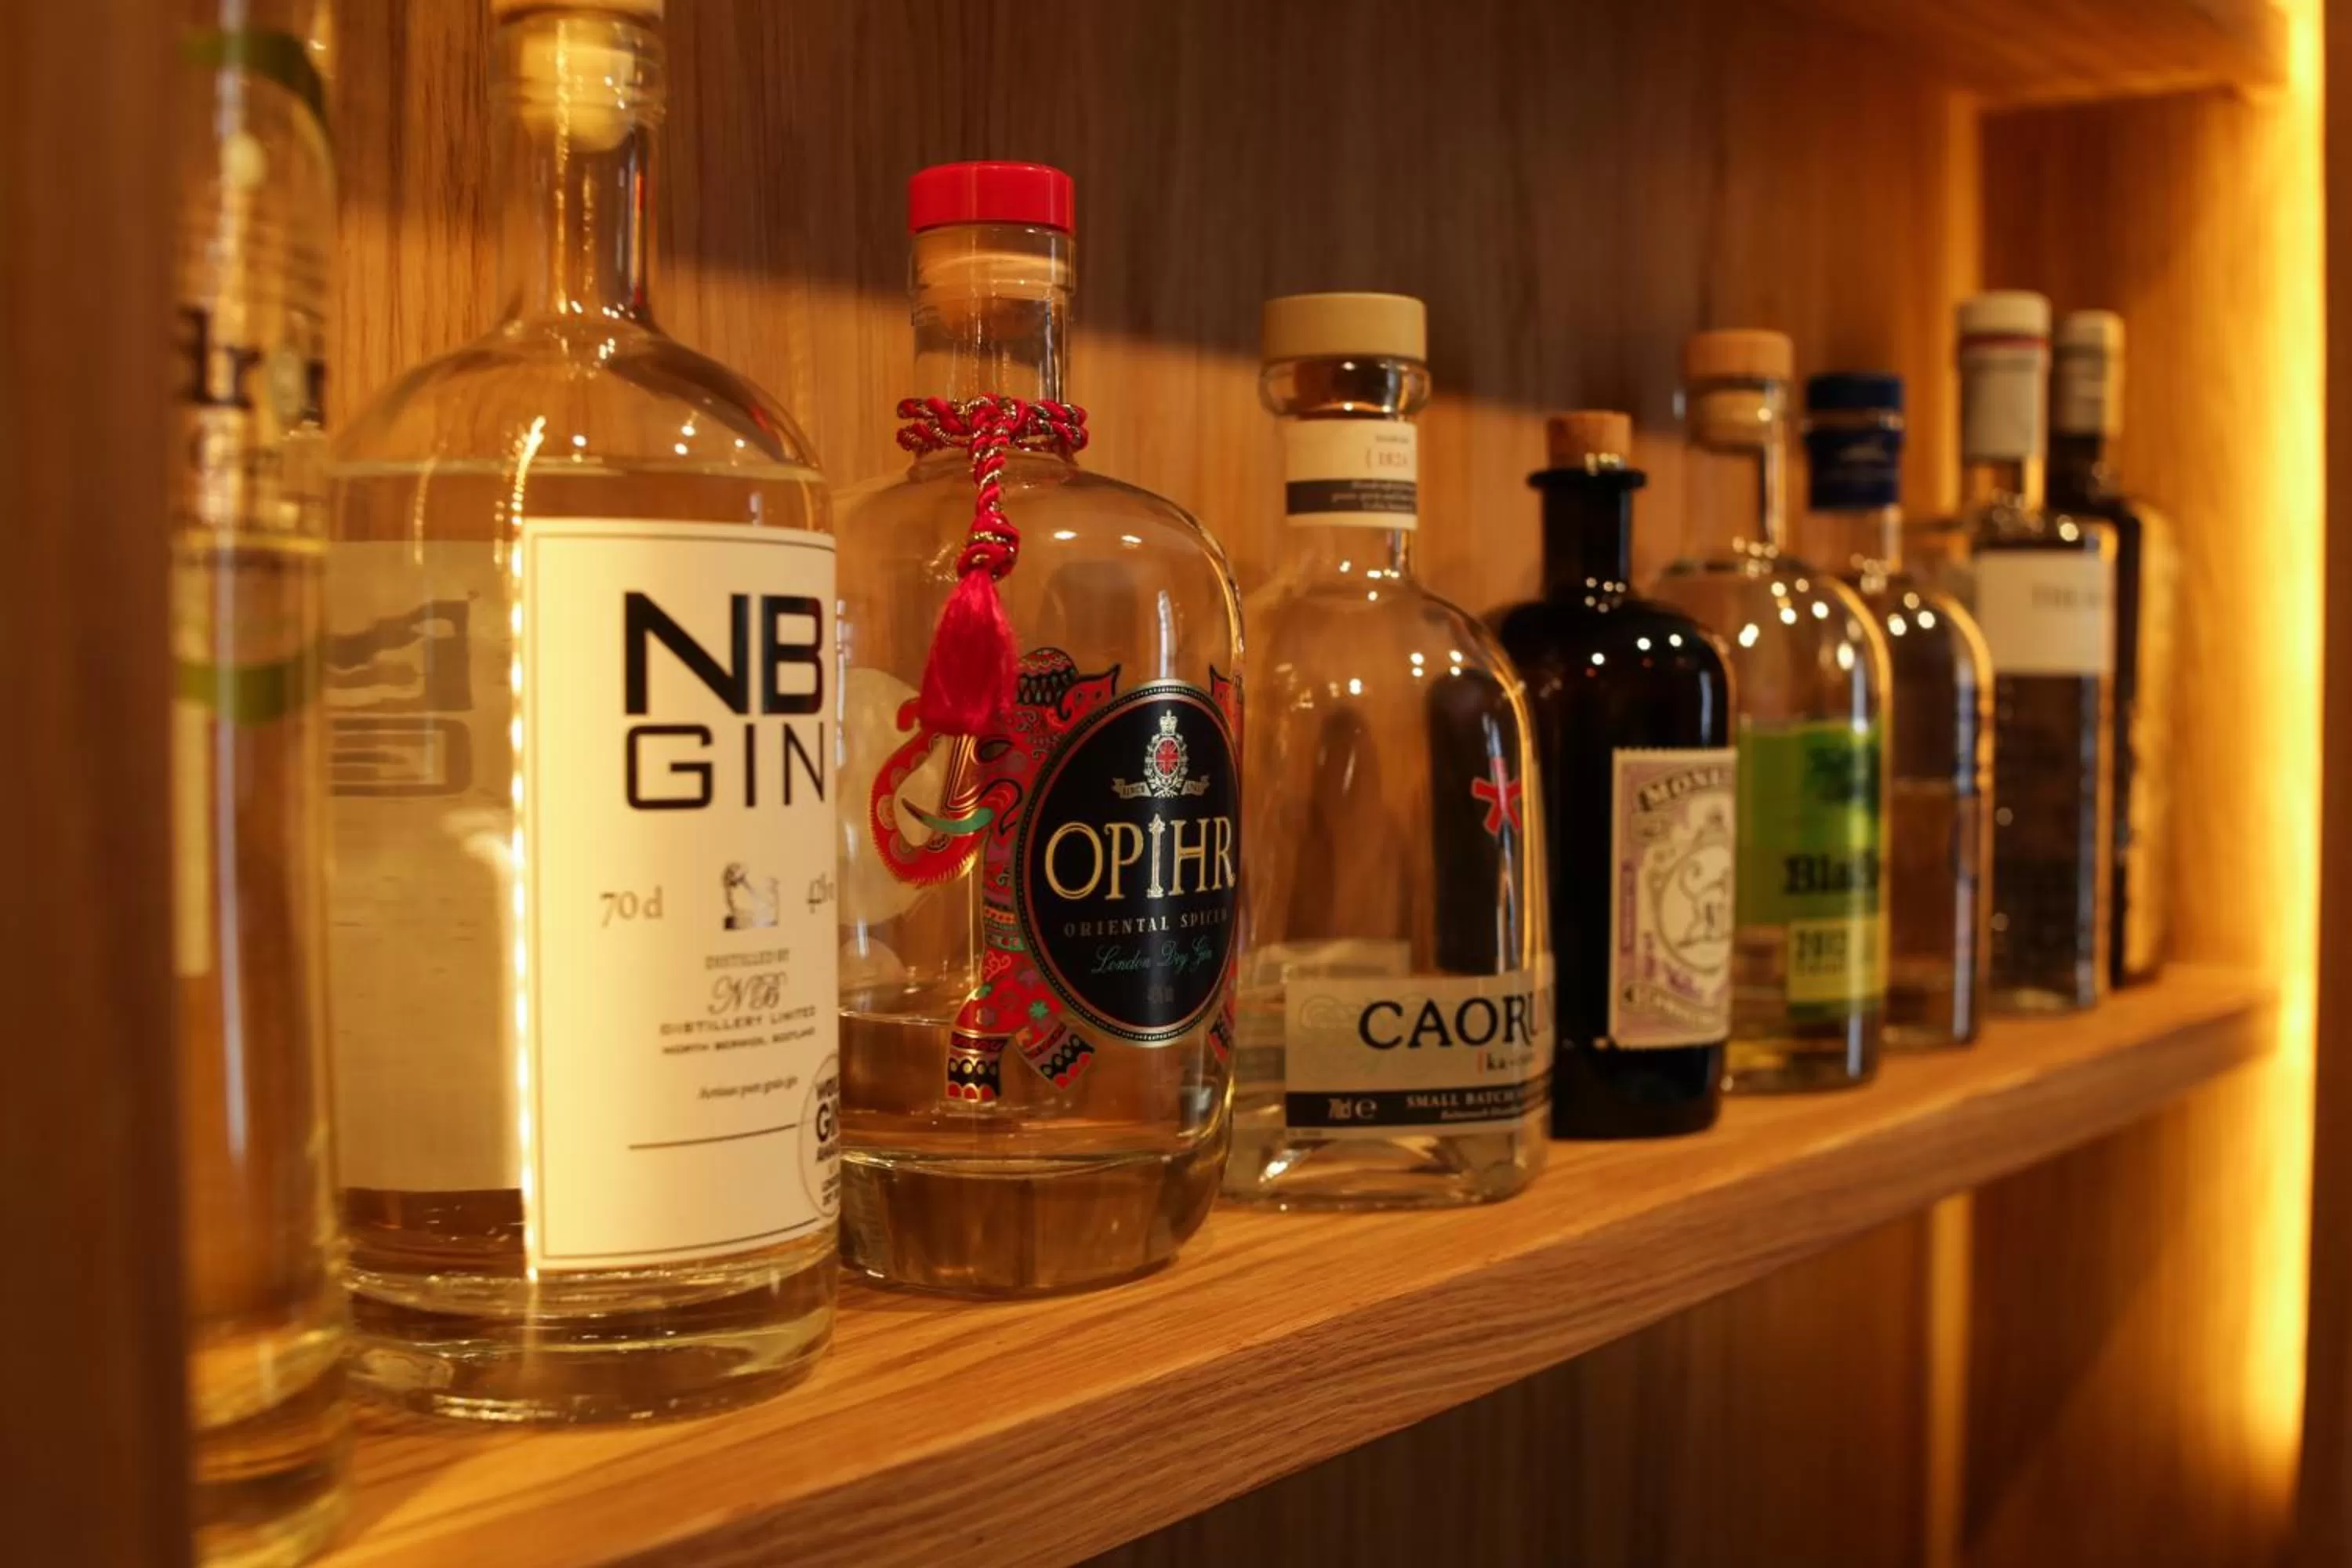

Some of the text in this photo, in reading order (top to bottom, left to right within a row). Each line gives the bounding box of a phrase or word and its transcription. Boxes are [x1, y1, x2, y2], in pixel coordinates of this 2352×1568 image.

[624, 591, 823, 715] NB
[624, 722, 825, 811] GIN
[1044, 813, 1236, 899] OPIHR
[1064, 915, 1171, 938] ORIENTAL
[1091, 943, 1152, 975] London
[1156, 940, 1189, 975] Dry
[659, 1014, 764, 1036] DISTILLERY
[1405, 1092, 1460, 1109] SMALL
